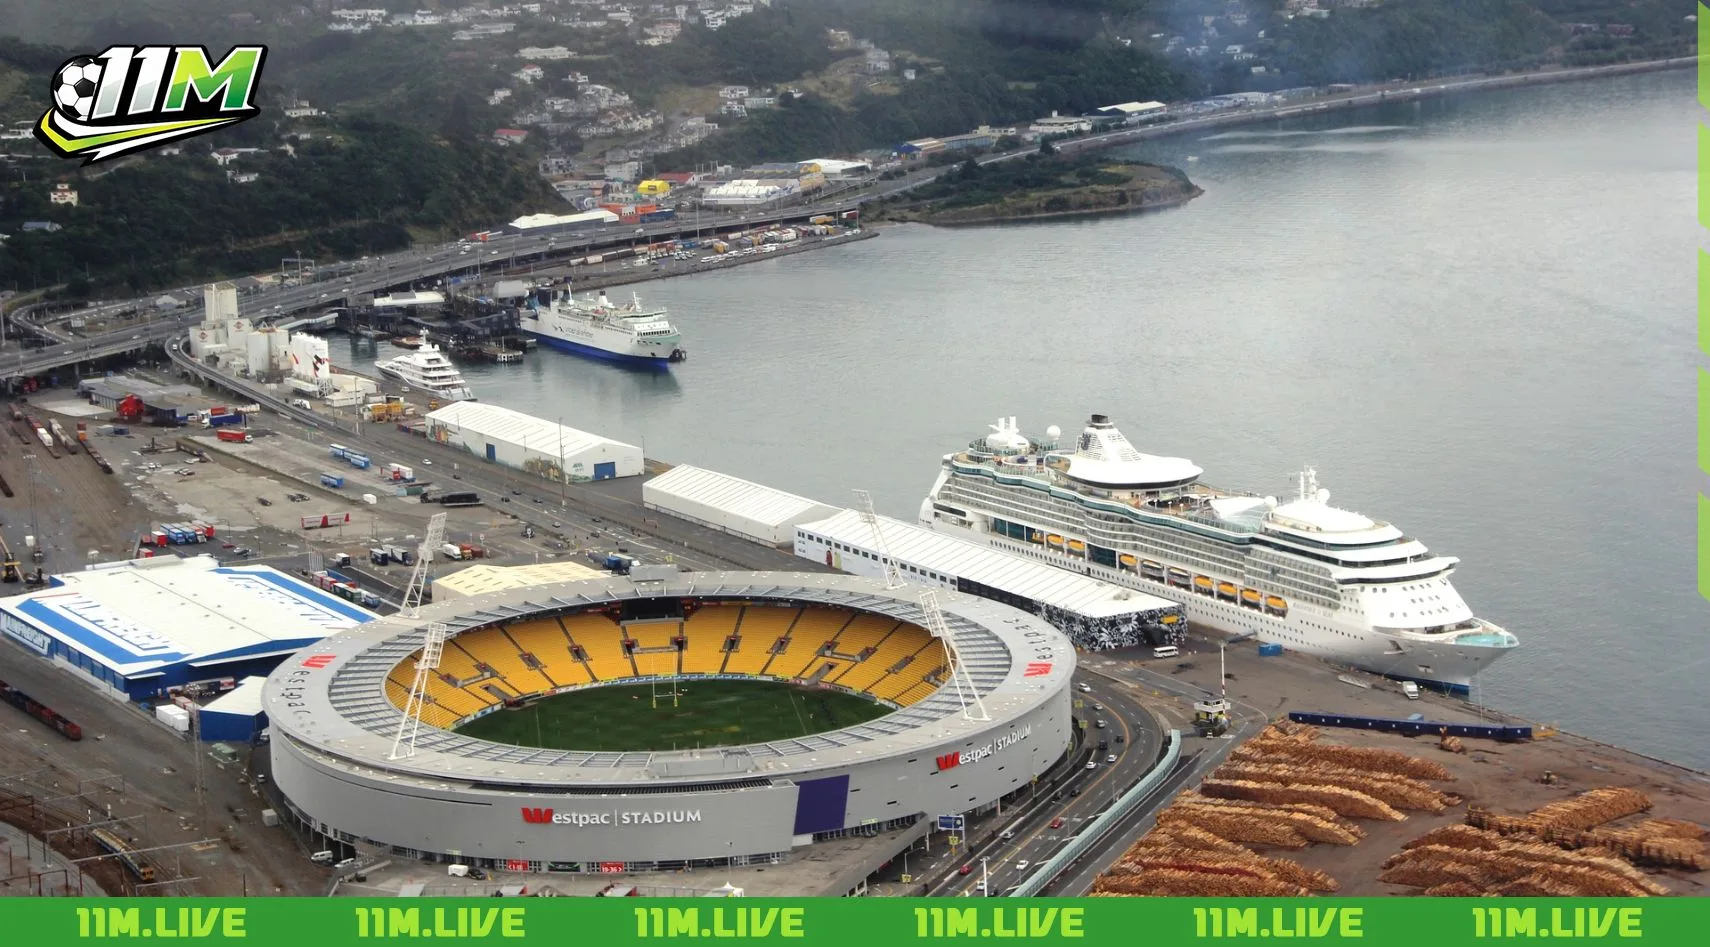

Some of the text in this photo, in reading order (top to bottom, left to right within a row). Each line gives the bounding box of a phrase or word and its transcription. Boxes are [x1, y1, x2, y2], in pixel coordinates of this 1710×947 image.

[936, 724, 1032, 771] Westpac STADIUM
[521, 807, 702, 827] Westpac STADIUM
